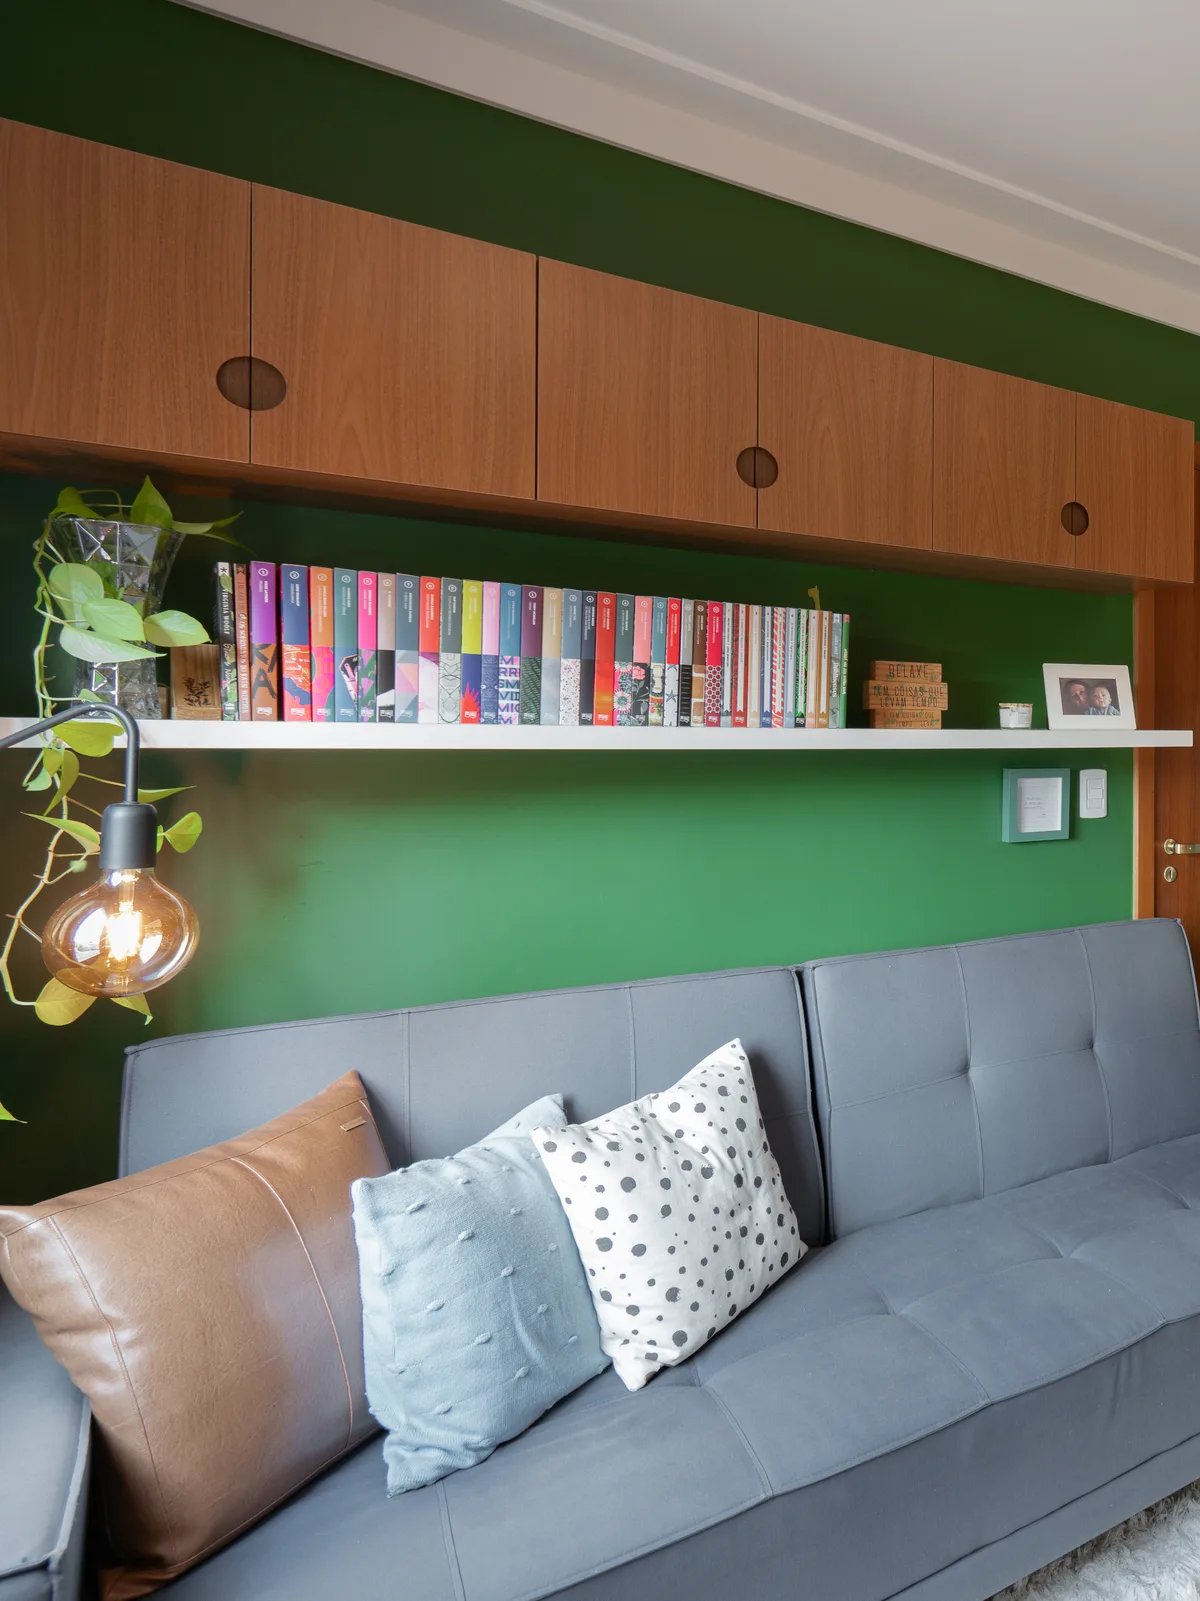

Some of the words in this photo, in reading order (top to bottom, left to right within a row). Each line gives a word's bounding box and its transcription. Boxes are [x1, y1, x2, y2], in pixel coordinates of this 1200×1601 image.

[222, 588, 230, 614] VIRGINIA
[223, 615, 231, 635] WOOLF
[888, 663, 929, 679] RELAXE
[832, 662, 841, 698] Dublinenses
[873, 686, 890, 697] TEM
[894, 685, 924, 697] COISAS
[928, 686, 944, 697] QUE
[880, 697, 907, 708] LEVAM
[912, 696, 938, 708] TEMPO
[925, 711, 934, 719] QUE
